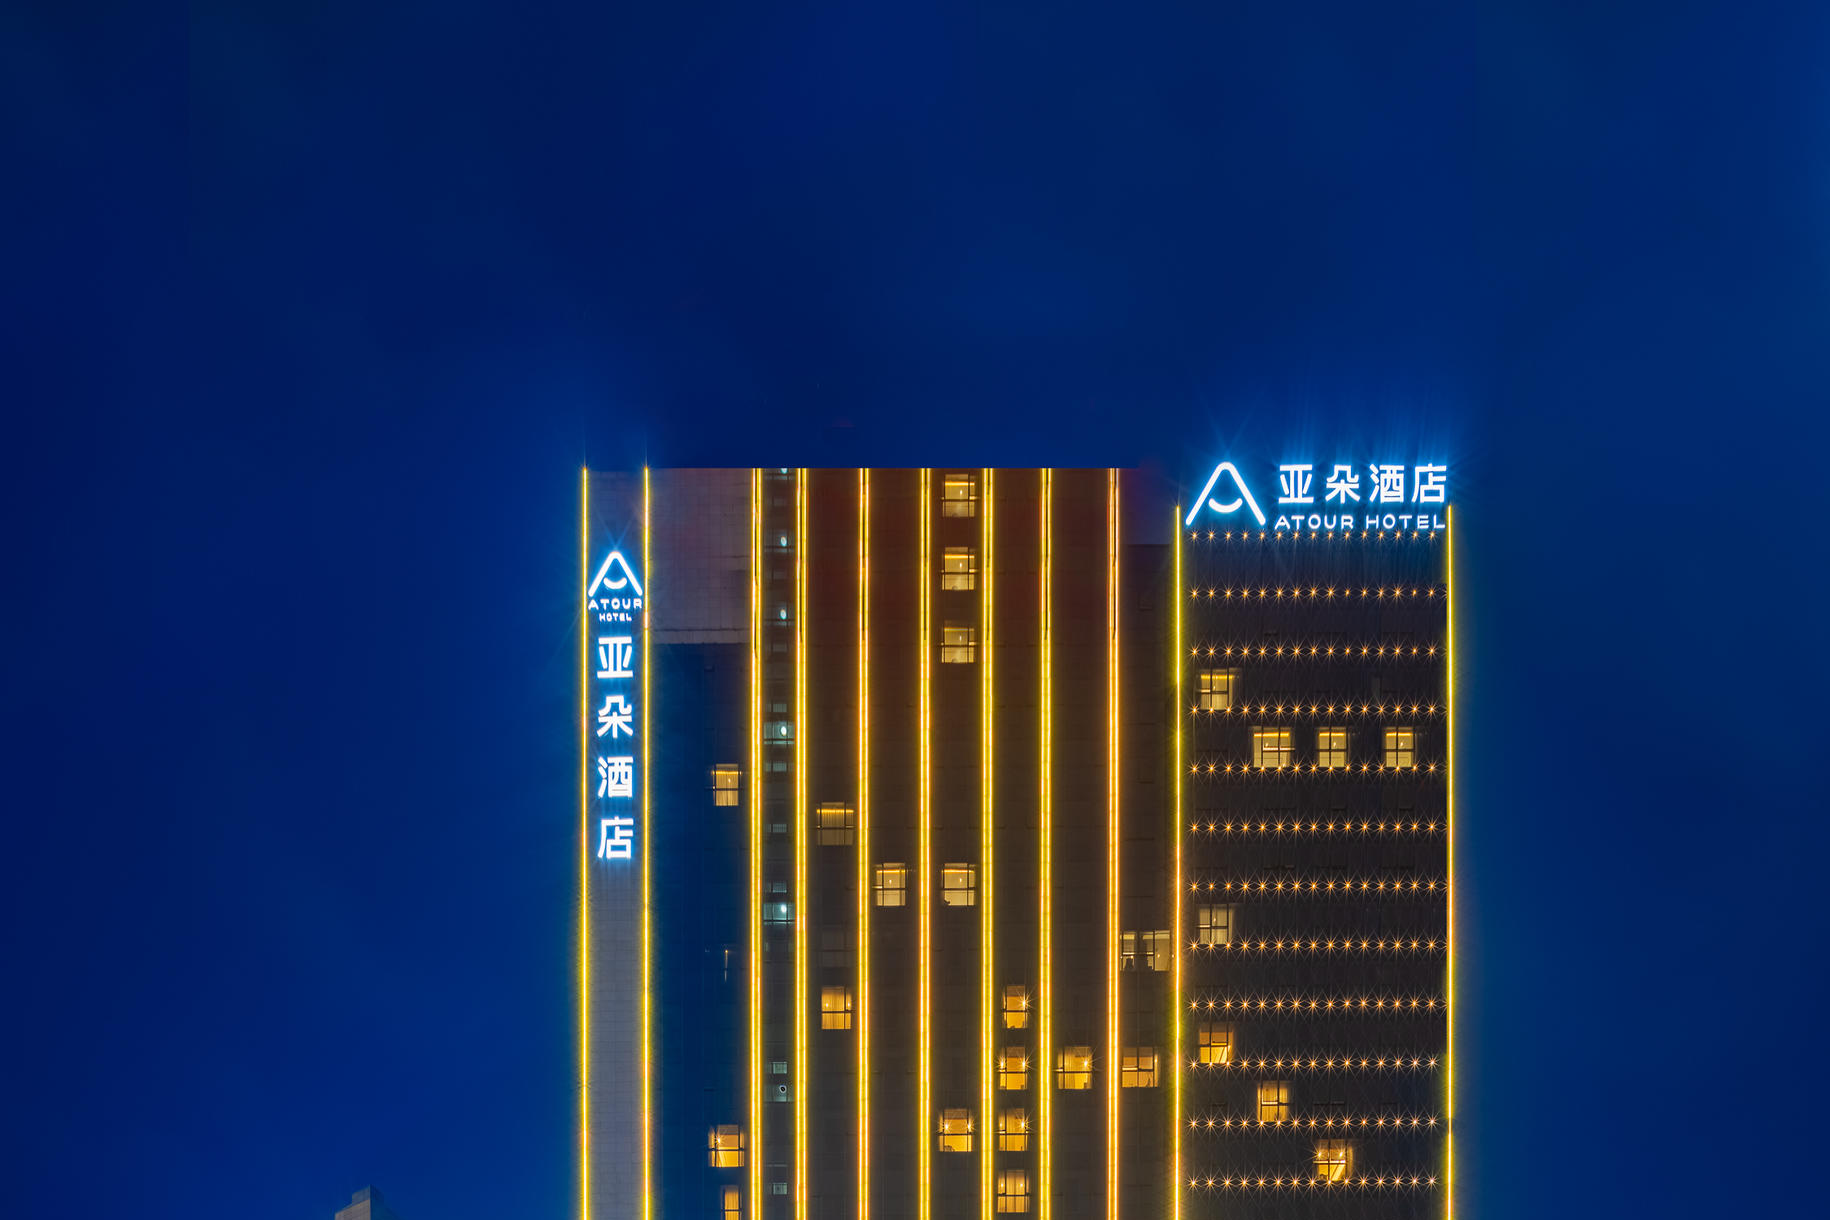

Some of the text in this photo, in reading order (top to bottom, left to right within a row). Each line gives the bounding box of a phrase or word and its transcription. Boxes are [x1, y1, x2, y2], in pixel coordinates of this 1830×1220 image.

[1278, 463, 1447, 503] 亚朵酒店
[1274, 514, 1446, 529] ATOUR HOTEL
[588, 598, 643, 610] ATOUR
[599, 612, 633, 622] HOTEL
[597, 636, 634, 859] 亚朵酒店
